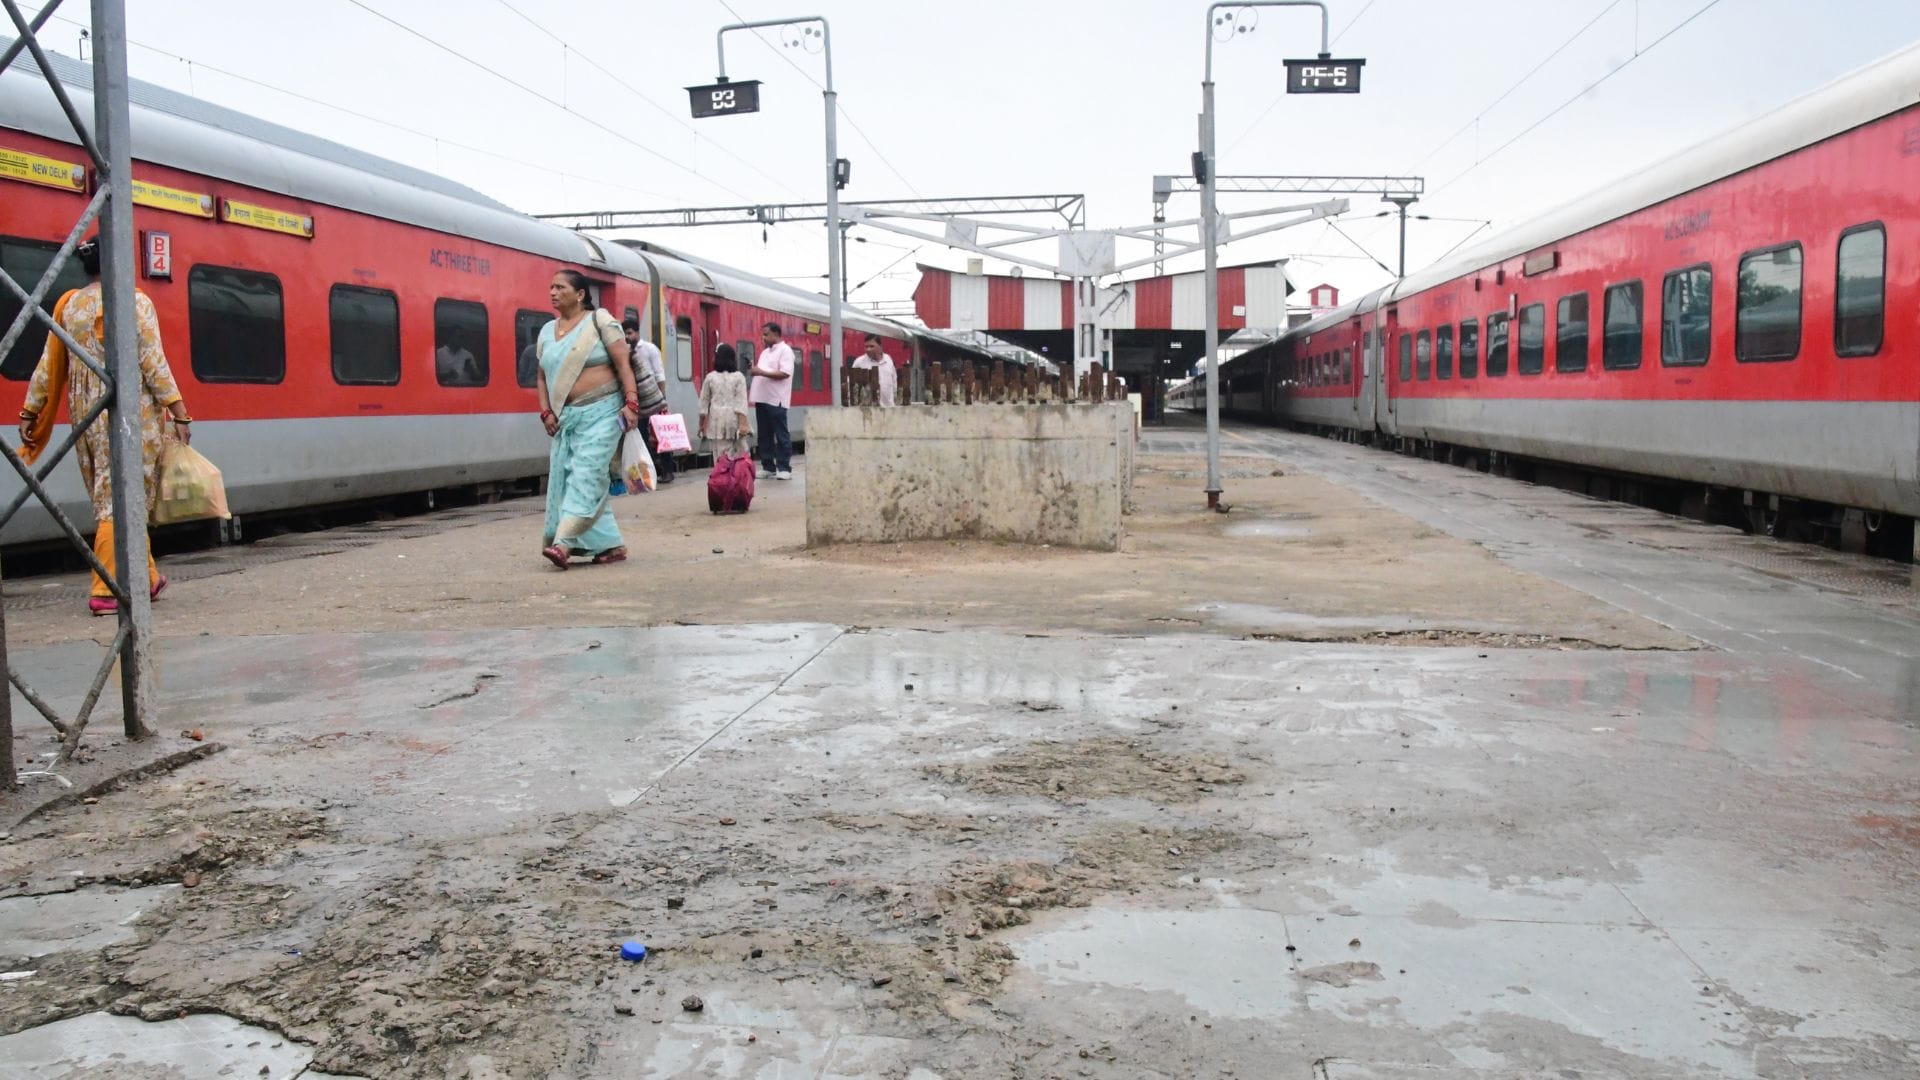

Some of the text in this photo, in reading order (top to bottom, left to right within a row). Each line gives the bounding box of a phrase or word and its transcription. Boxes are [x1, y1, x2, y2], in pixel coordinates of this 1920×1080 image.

[32, 162, 68, 179] NEW DELHI
[154, 236, 165, 252] B
[153, 256, 166, 271] 4
[430, 248, 491, 276] AC THREE TIER
